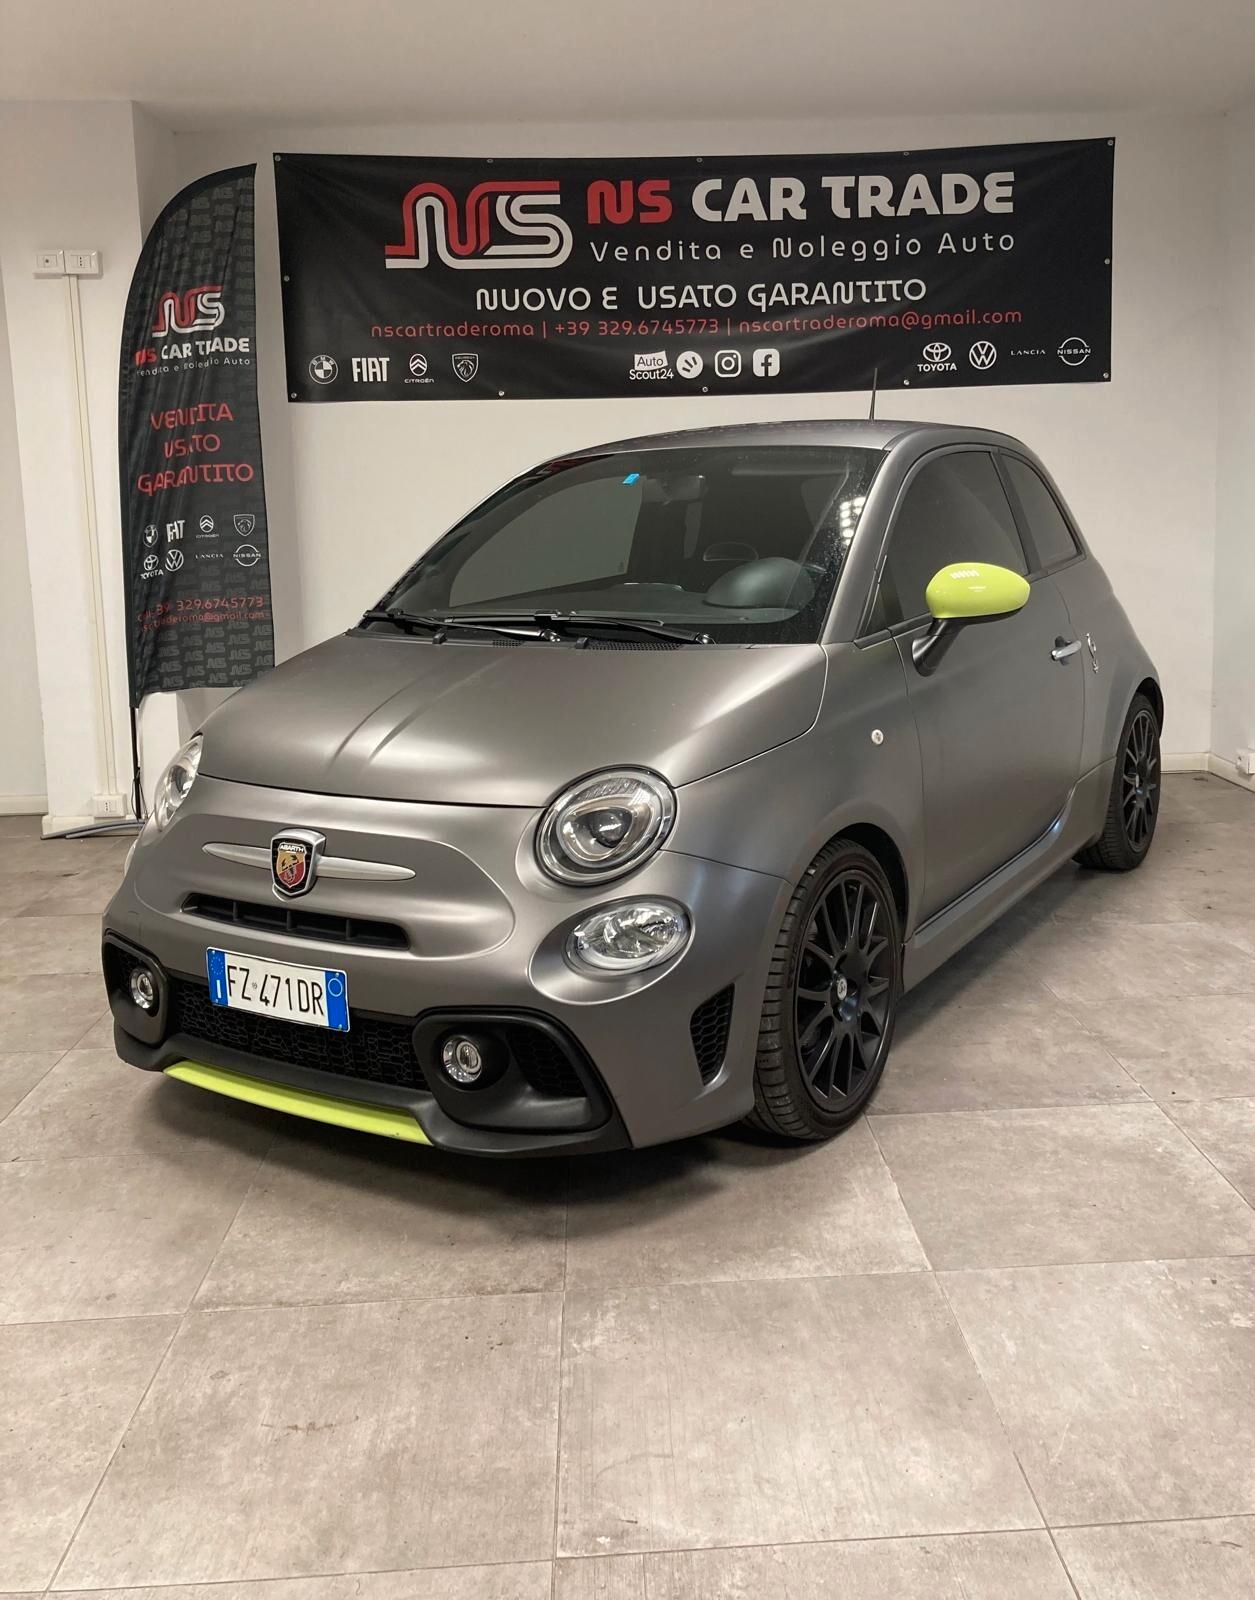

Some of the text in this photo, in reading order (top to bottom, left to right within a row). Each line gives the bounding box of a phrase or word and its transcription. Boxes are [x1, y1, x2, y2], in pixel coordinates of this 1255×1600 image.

[587, 171, 1015, 225] NS CAR TRADE
[590, 232, 1015, 262] Vendita e Noleggio Auto
[476, 278, 927, 313] NUOVO E USATO GARANTITO
[371, 320, 535, 338] nscartraderoma
[555, 320, 590, 337] +39
[598, 318, 719, 336] 329.6745773
[739, 310, 1022, 334] nscartraderoma@gmail.com
[161, 342, 192, 360] CAR
[223, 356, 251, 366] Auto
[636, 356, 664, 367] Auto
[351, 357, 390, 383] FIAT
[629, 368, 675, 381] Scout24
[917, 362, 958, 373] TOYOTA
[227, 965, 325, 1016] FZ 471DR
